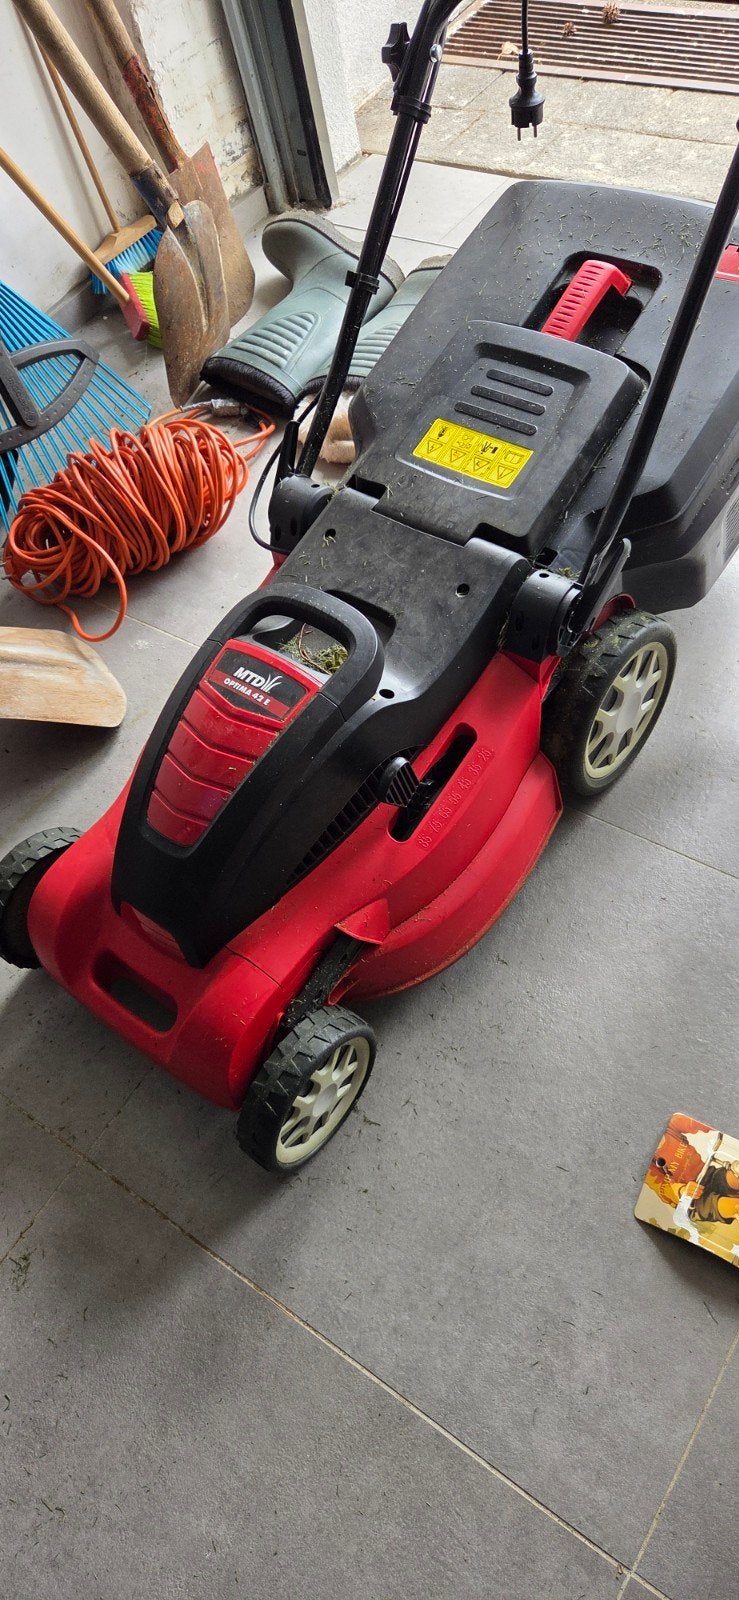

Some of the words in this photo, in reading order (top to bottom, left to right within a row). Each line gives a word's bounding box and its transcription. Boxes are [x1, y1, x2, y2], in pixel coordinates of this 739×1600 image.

[233, 666, 266, 688] MTD
[223, 678, 252, 696] OPTIMA
[251, 692, 264, 703] 42
[263, 698, 271, 706] E
[417, 833, 432, 848] 85
[428, 818, 443, 832] 75
[667, 1161, 680, 1173] MY
[674, 1142, 687, 1158] BIKE
